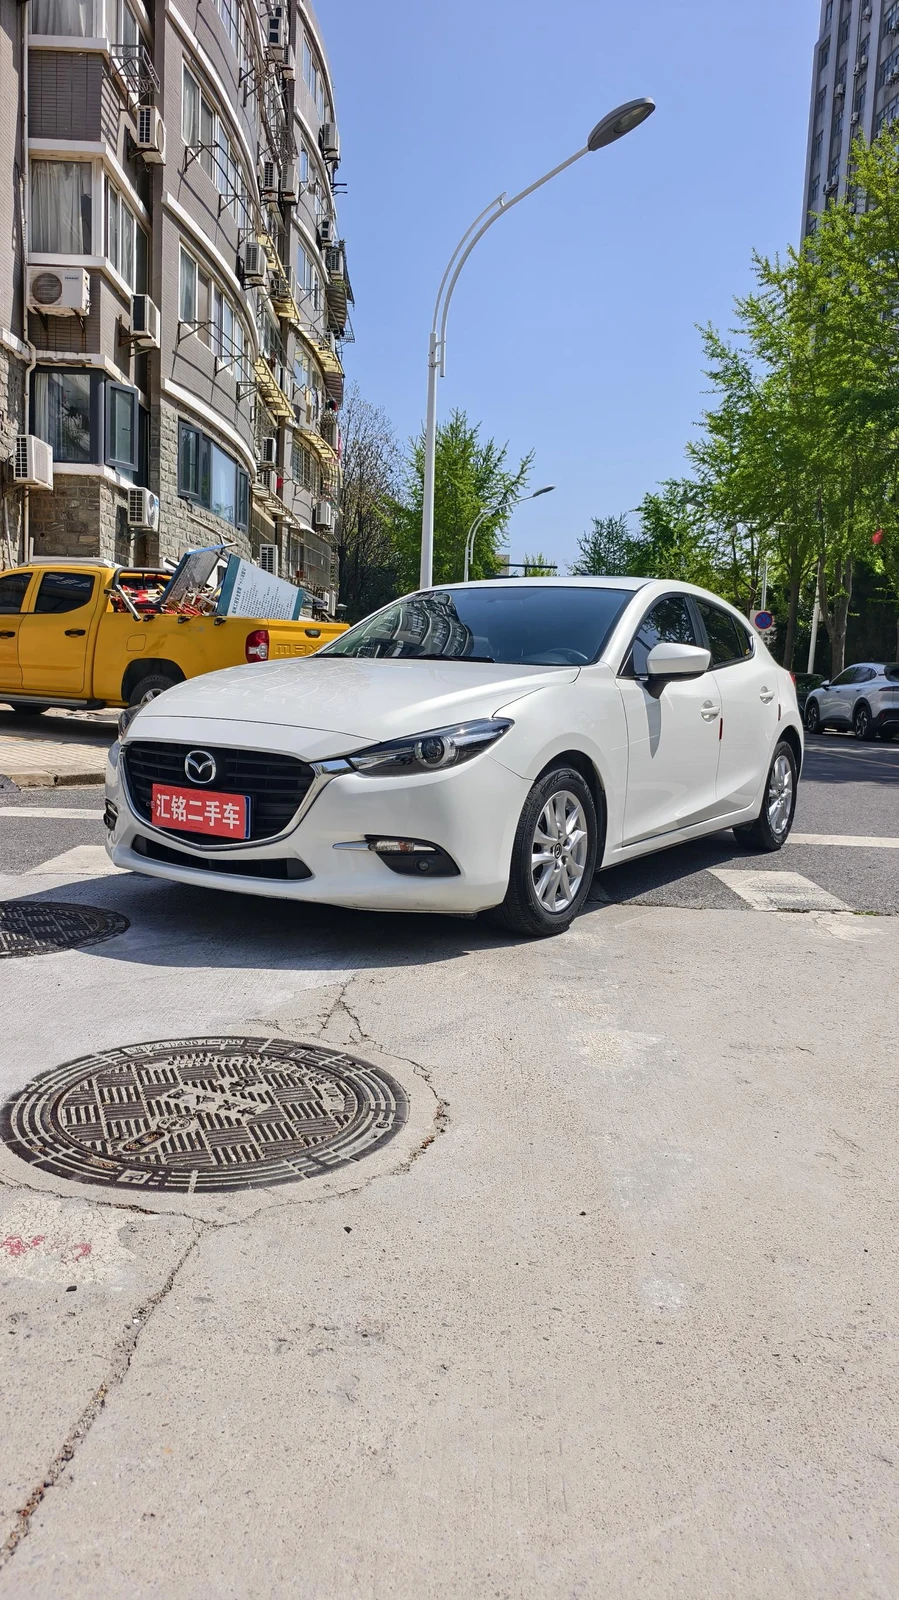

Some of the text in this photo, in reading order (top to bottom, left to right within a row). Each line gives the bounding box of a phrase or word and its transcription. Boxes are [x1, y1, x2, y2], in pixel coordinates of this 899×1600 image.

[156, 793, 240, 830] 汇铭二手车
